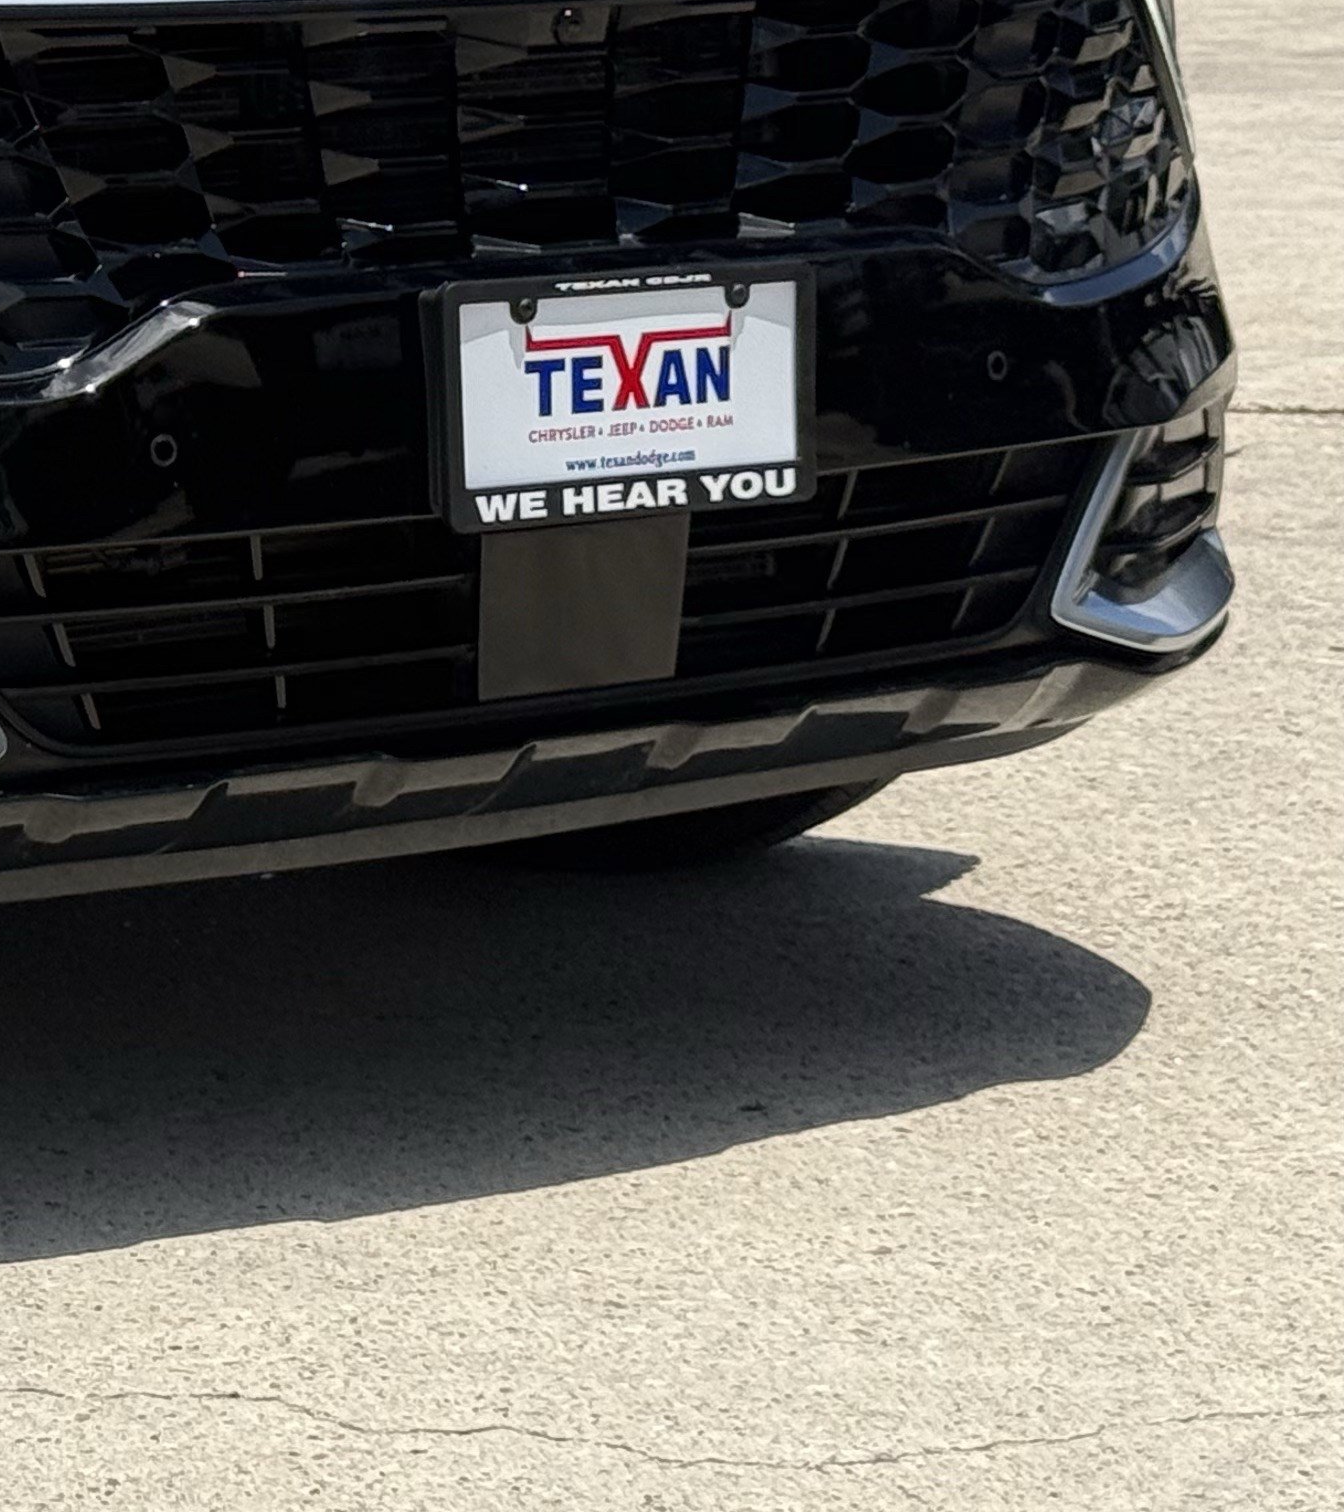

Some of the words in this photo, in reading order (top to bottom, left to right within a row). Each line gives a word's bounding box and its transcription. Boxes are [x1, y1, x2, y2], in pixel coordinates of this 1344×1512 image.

[554, 277, 641, 292] TEXAN
[524, 333, 731, 418] TEXAN
[528, 425, 596, 444] CHRYSLER
[607, 422, 637, 438] JEEP
[649, 417, 694, 433] DODGE
[706, 414, 734, 429] RAM
[565, 449, 696, 472] www.texandodge.com
[475, 490, 549, 524] WE
[562, 476, 689, 517] HEAR
[700, 466, 798, 504] YOU
